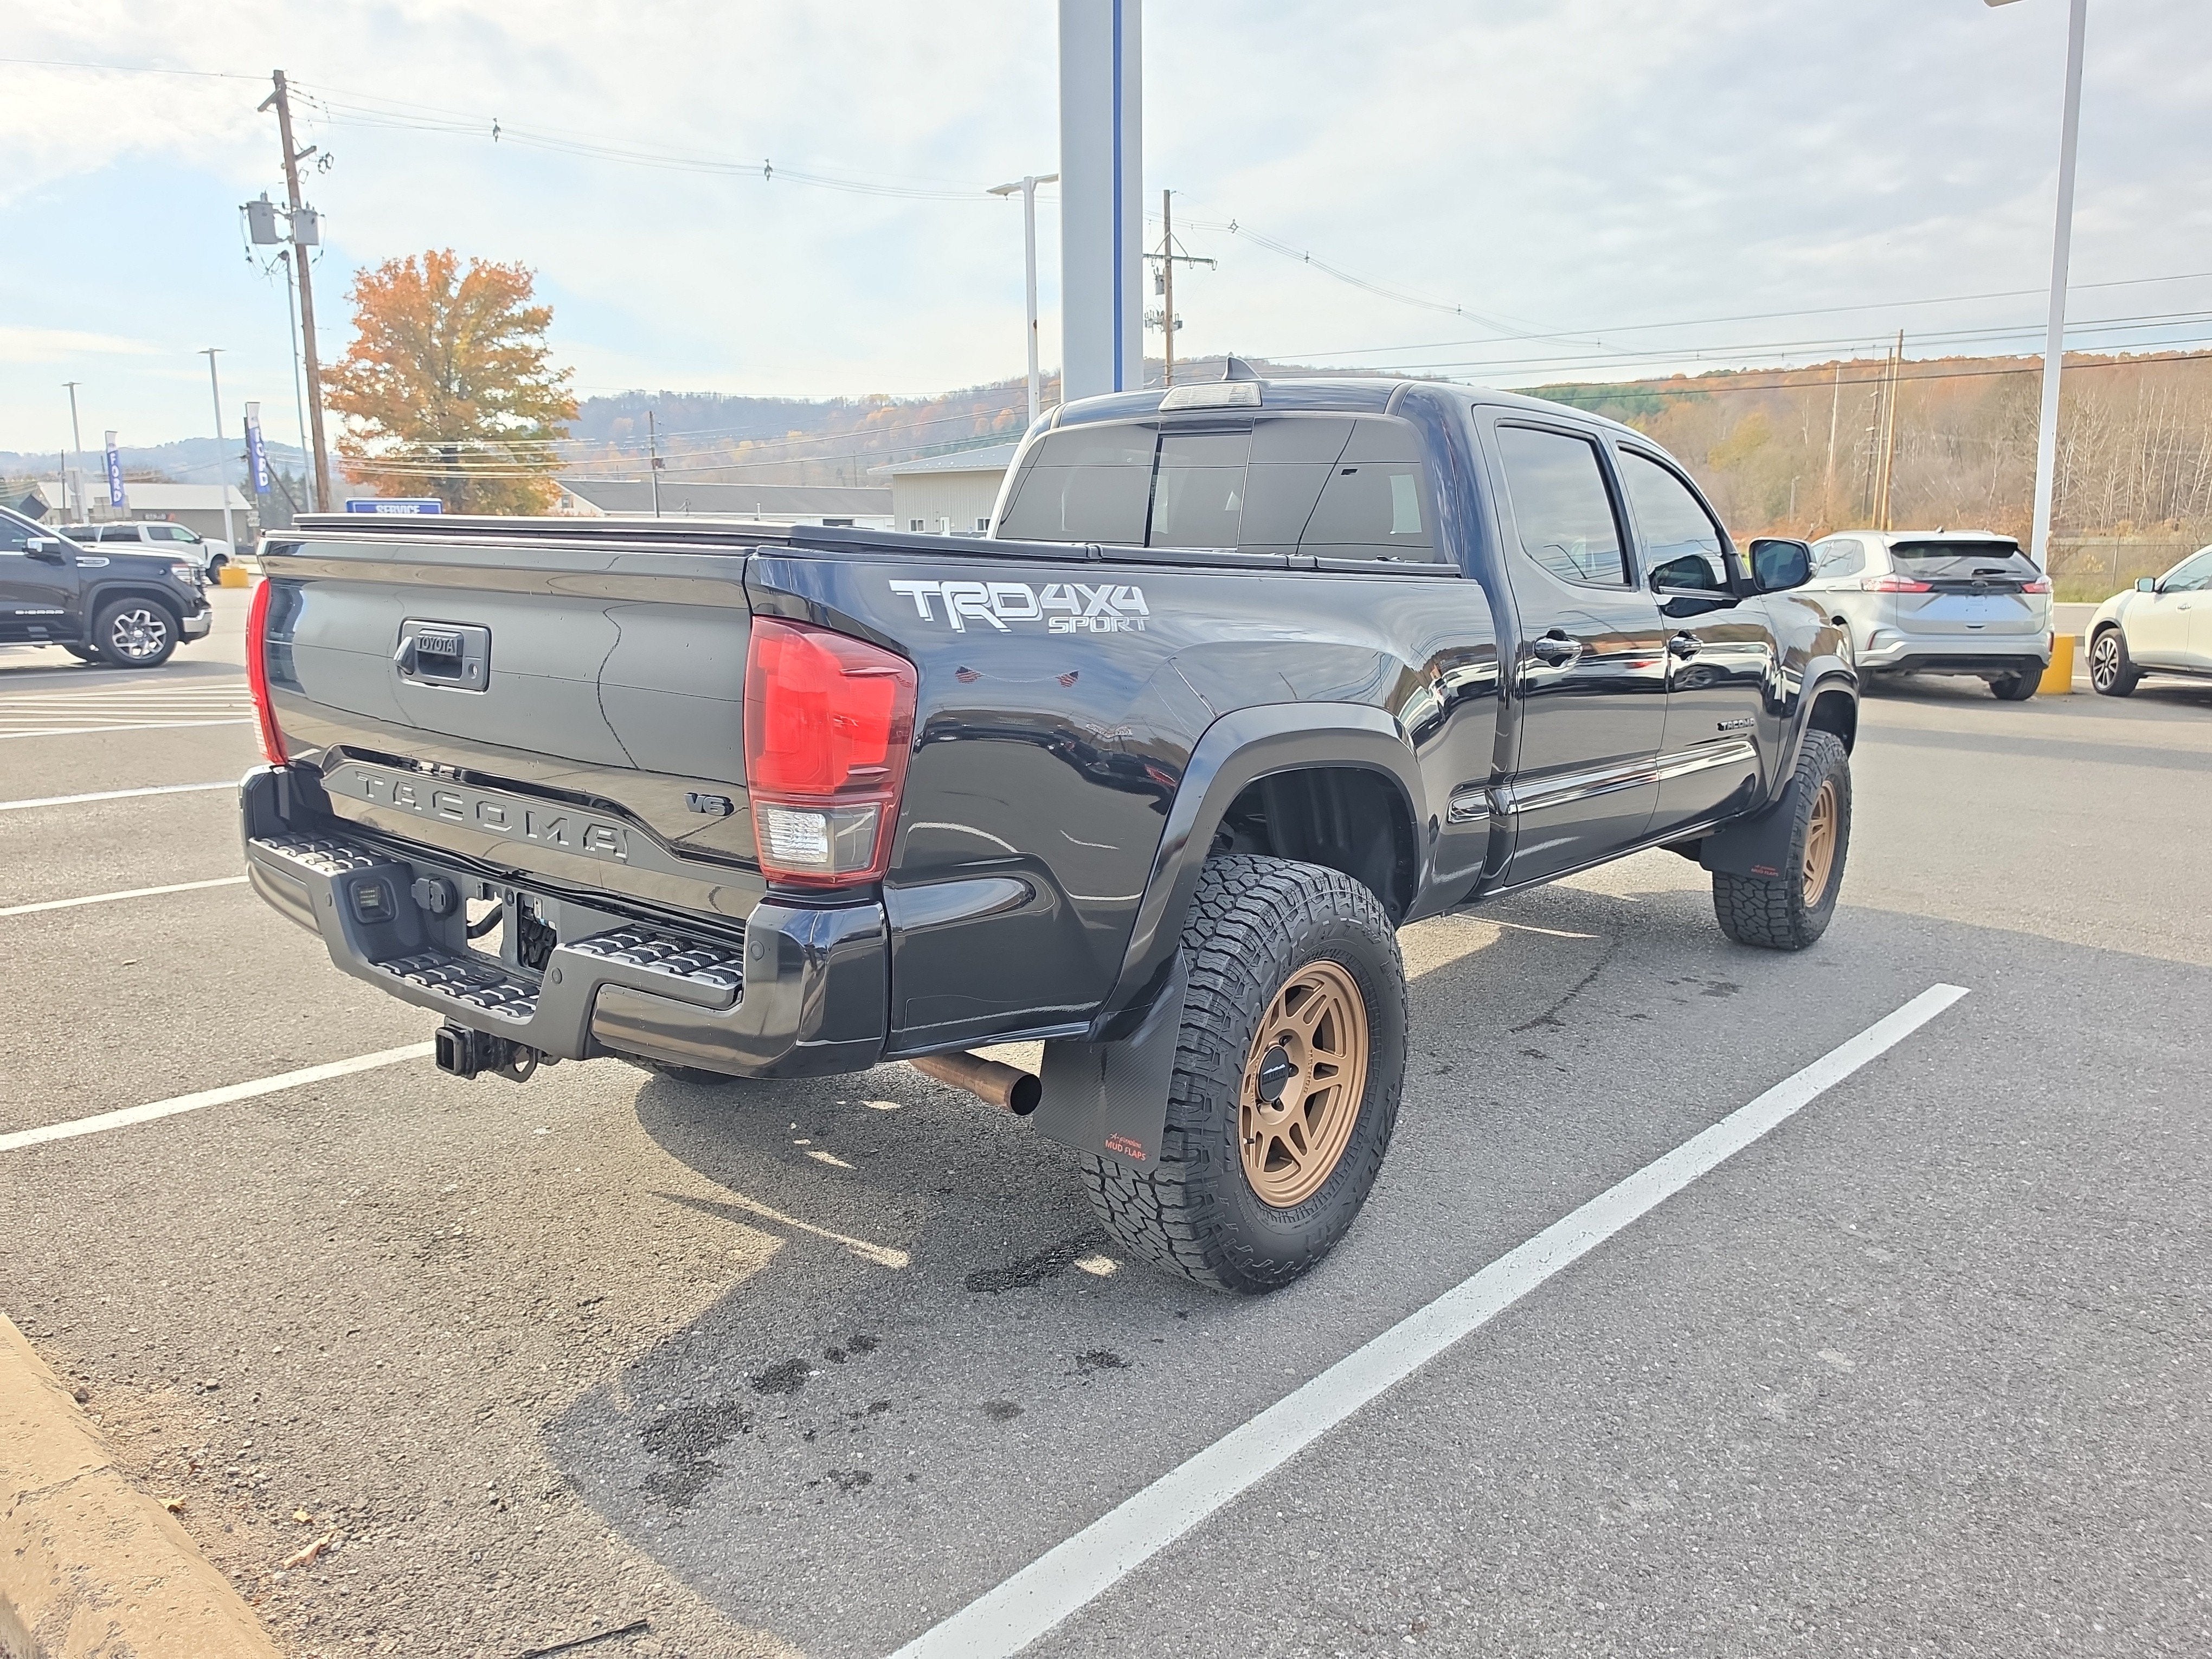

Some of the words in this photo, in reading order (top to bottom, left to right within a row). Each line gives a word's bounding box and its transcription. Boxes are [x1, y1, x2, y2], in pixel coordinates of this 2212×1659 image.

[110, 452, 122, 503] FORD
[376, 505, 420, 513] SERVICE
[889, 580, 1043, 634] TRD
[1048, 616, 1150, 634] SPORT
[417, 635, 455, 653] TOYOTA
[1717, 717, 1755, 731] TACOMA
[355, 769, 629, 859] TACOMA
[683, 792, 735, 816] V6
[1105, 1139, 1123, 1152] MUD
[1124, 1147, 1146, 1161] FLAPS
